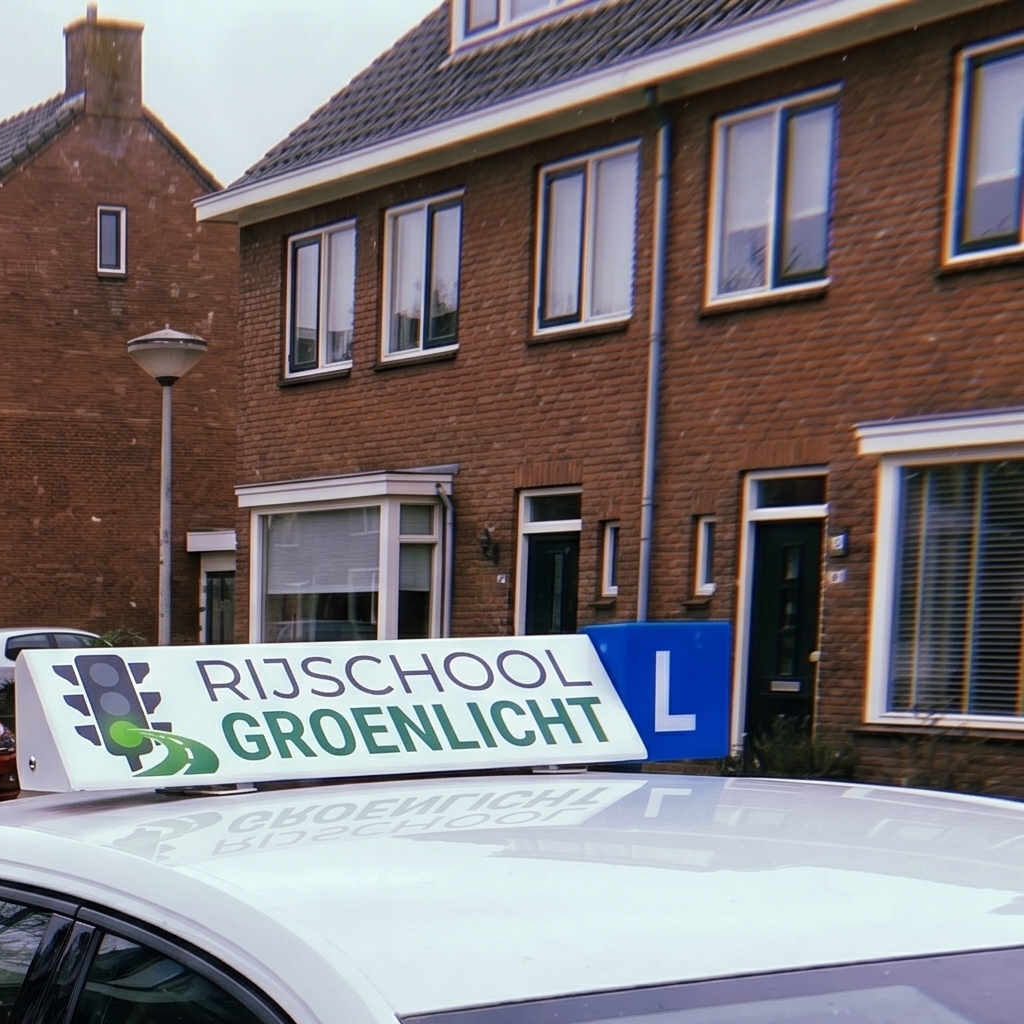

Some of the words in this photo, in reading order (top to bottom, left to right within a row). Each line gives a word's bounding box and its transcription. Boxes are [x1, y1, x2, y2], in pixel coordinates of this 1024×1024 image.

[195, 649, 593, 702] RIJSCHOOL
[654, 650, 697, 733] L
[221, 696, 610, 761] GROENLICHT
